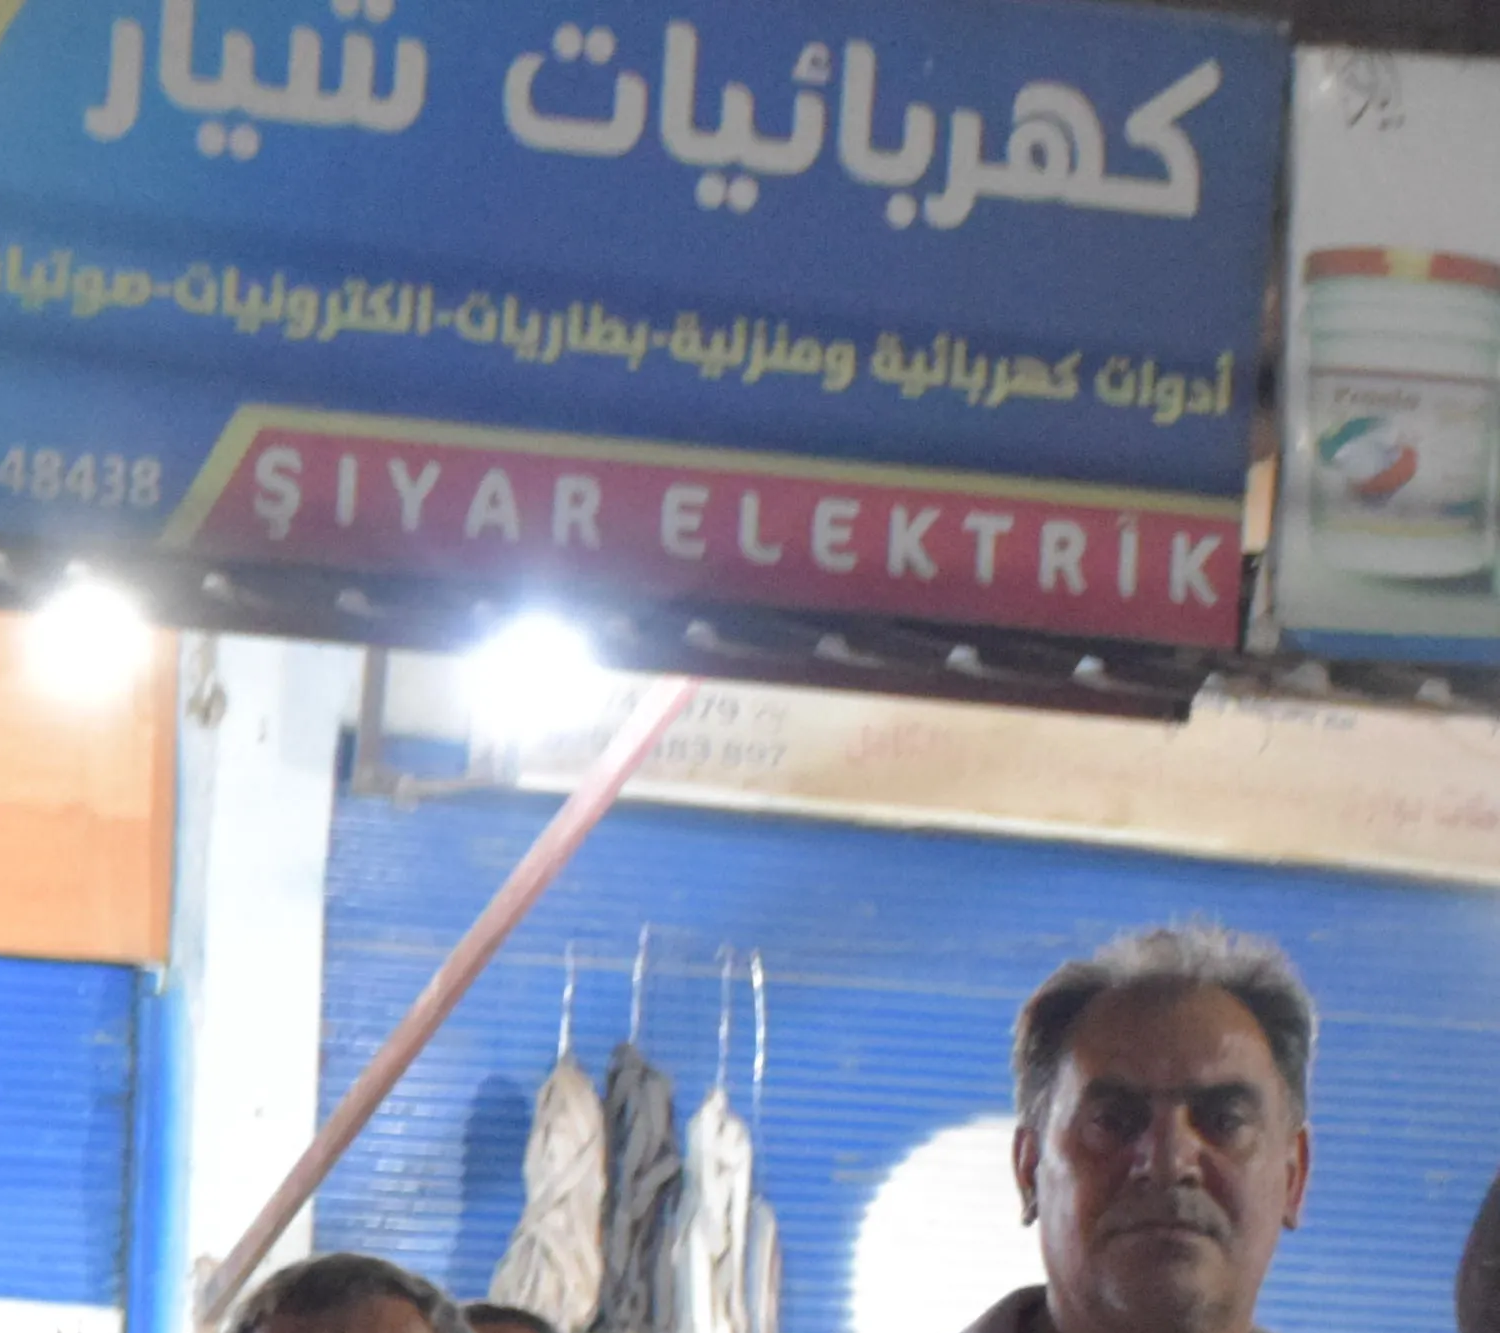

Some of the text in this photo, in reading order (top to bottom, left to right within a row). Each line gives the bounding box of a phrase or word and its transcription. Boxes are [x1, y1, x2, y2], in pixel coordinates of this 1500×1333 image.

[84, 0, 1224, 232] كهربائيات شيار
[871, 331, 1082, 409] كهربائية
[1094, 350, 1234, 427] أدوات
[253, 445, 603, 549] ŞIYAR
